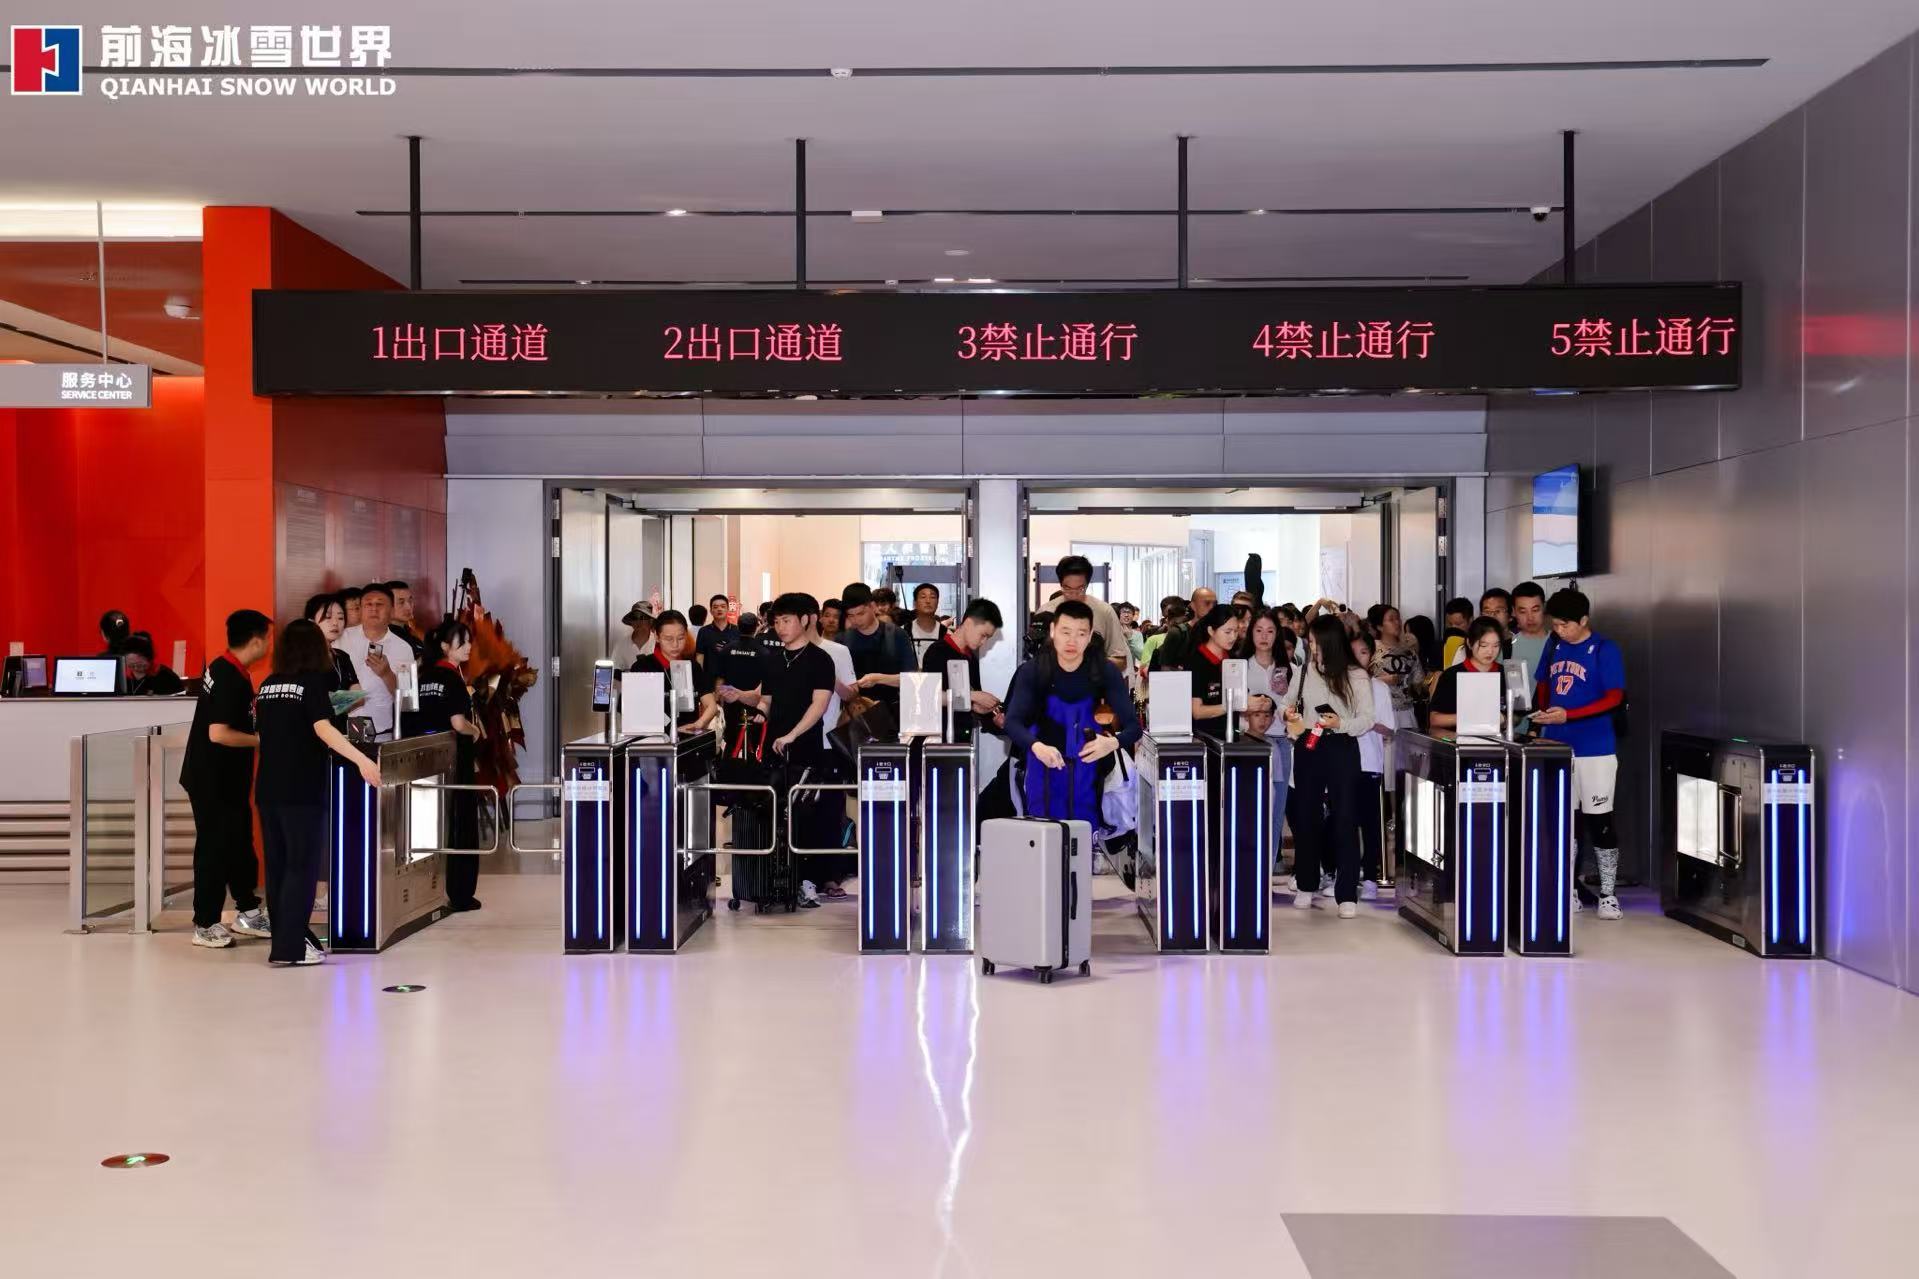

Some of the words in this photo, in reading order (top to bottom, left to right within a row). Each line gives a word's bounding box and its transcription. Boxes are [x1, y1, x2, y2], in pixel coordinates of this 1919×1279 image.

[372, 323, 548, 361] 1出口通道
[663, 323, 842, 362] 2出口通道
[957, 322, 1137, 361] 3禁止通行
[1252, 320, 1434, 360] 4禁止通行
[1551, 316, 1736, 357] 5禁止通行
[61, 371, 133, 389] 服务中心
[61, 390, 97, 400] SERVICE
[98, 390, 132, 400] CENTER
